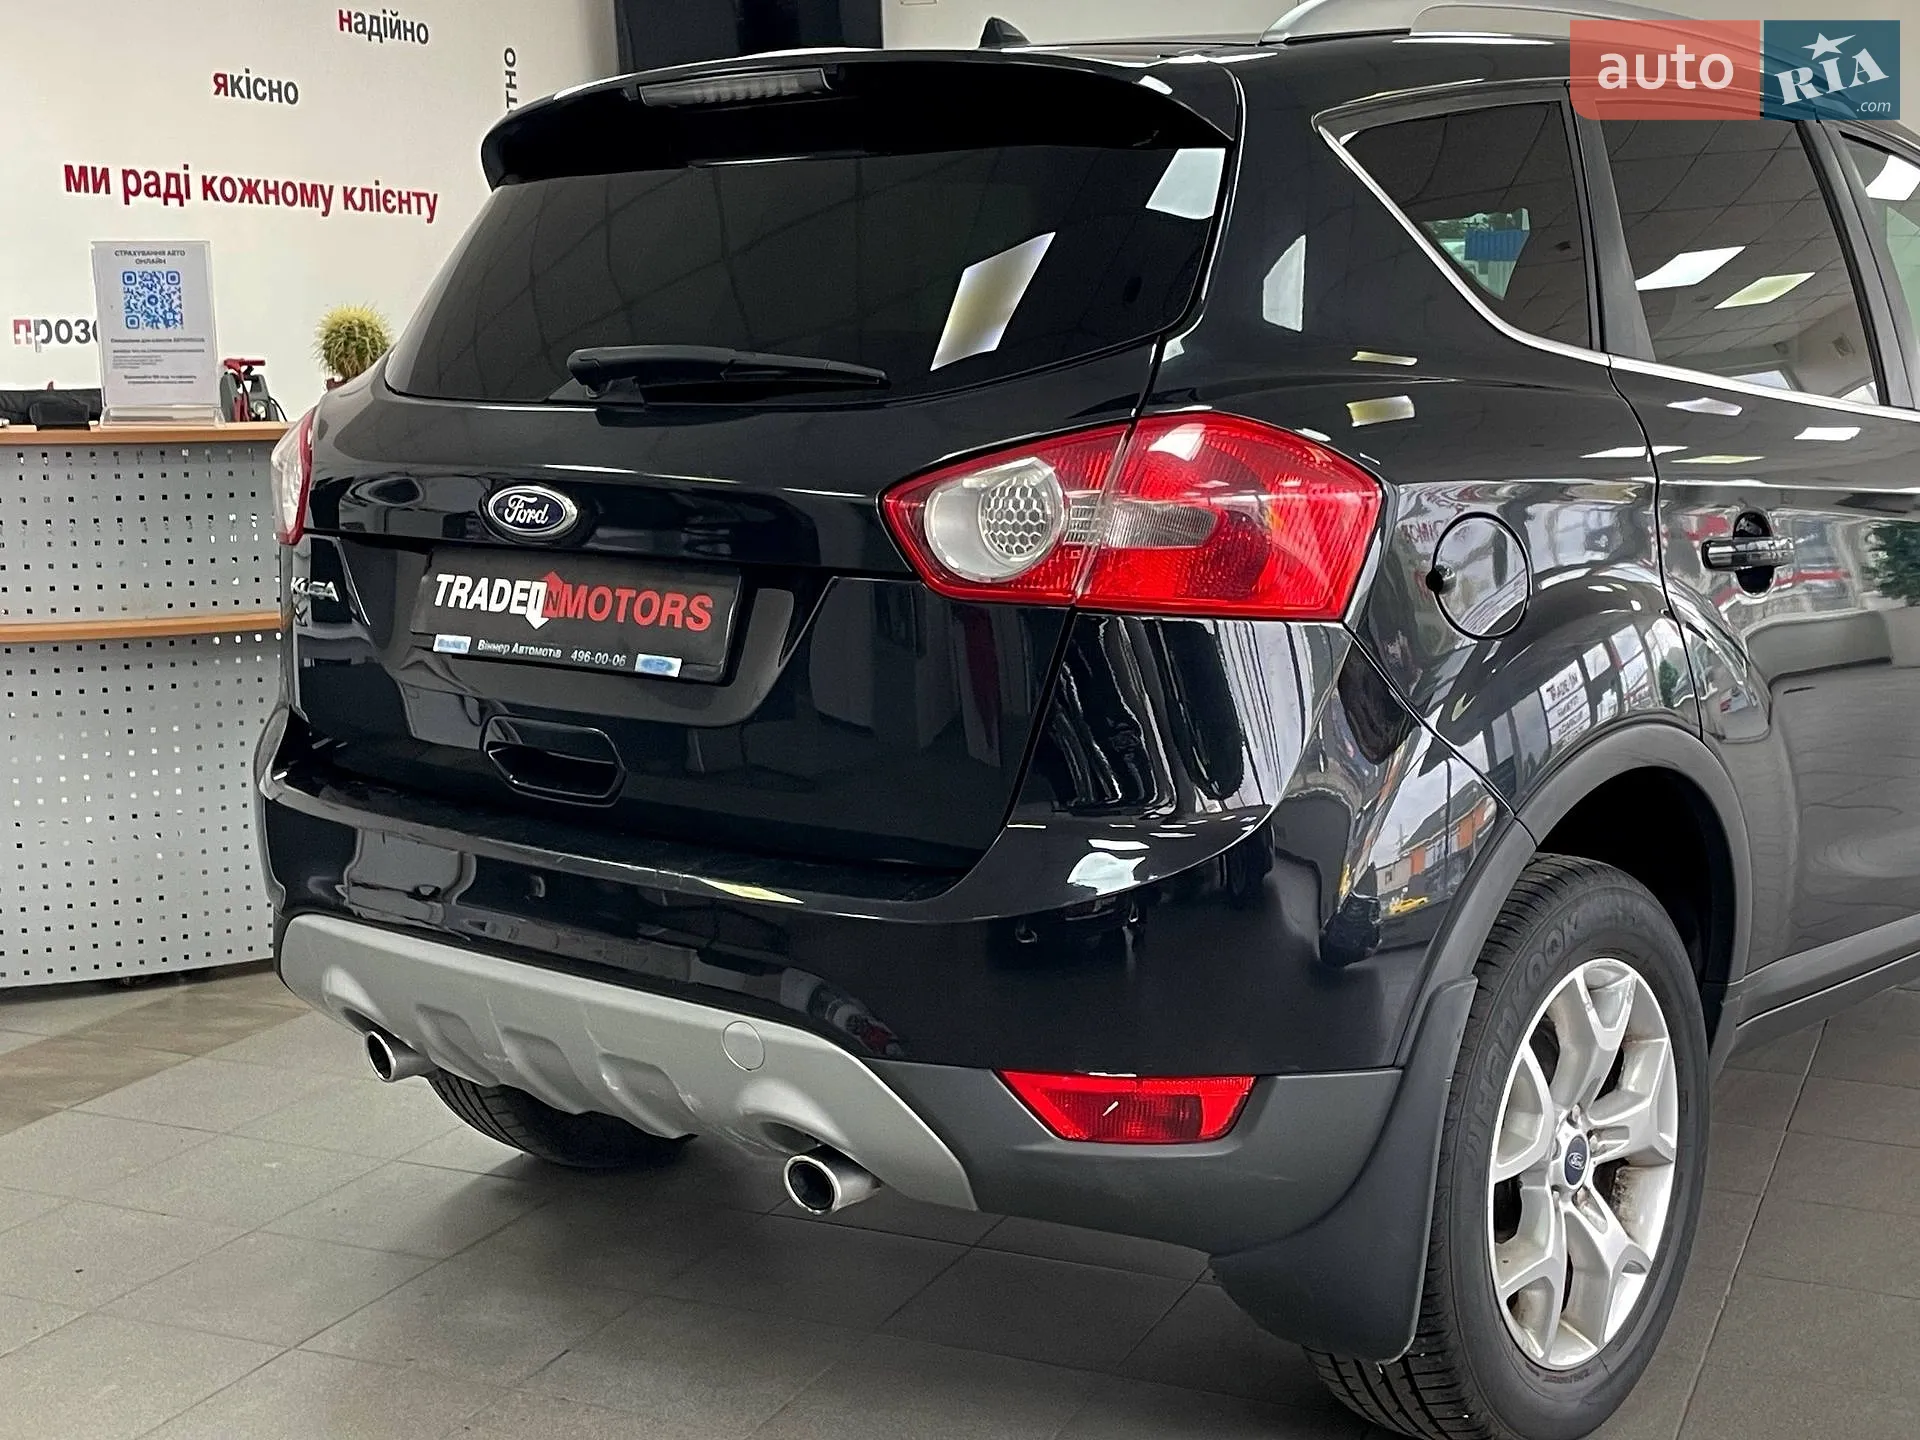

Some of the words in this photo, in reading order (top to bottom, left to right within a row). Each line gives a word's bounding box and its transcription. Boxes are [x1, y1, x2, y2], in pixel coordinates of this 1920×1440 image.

[338, 8, 429, 45] надійно
[213, 68, 299, 105] якісно
[504, 47, 518, 113] тно
[64, 164, 111, 195] ми
[122, 164, 191, 207] раді
[201, 175, 335, 217] кожному
[342, 180, 438, 224] клієнту
[13, 319, 98, 353] проз
[504, 494, 550, 525] Ford
[570, 649, 627, 667] 496-00-06
